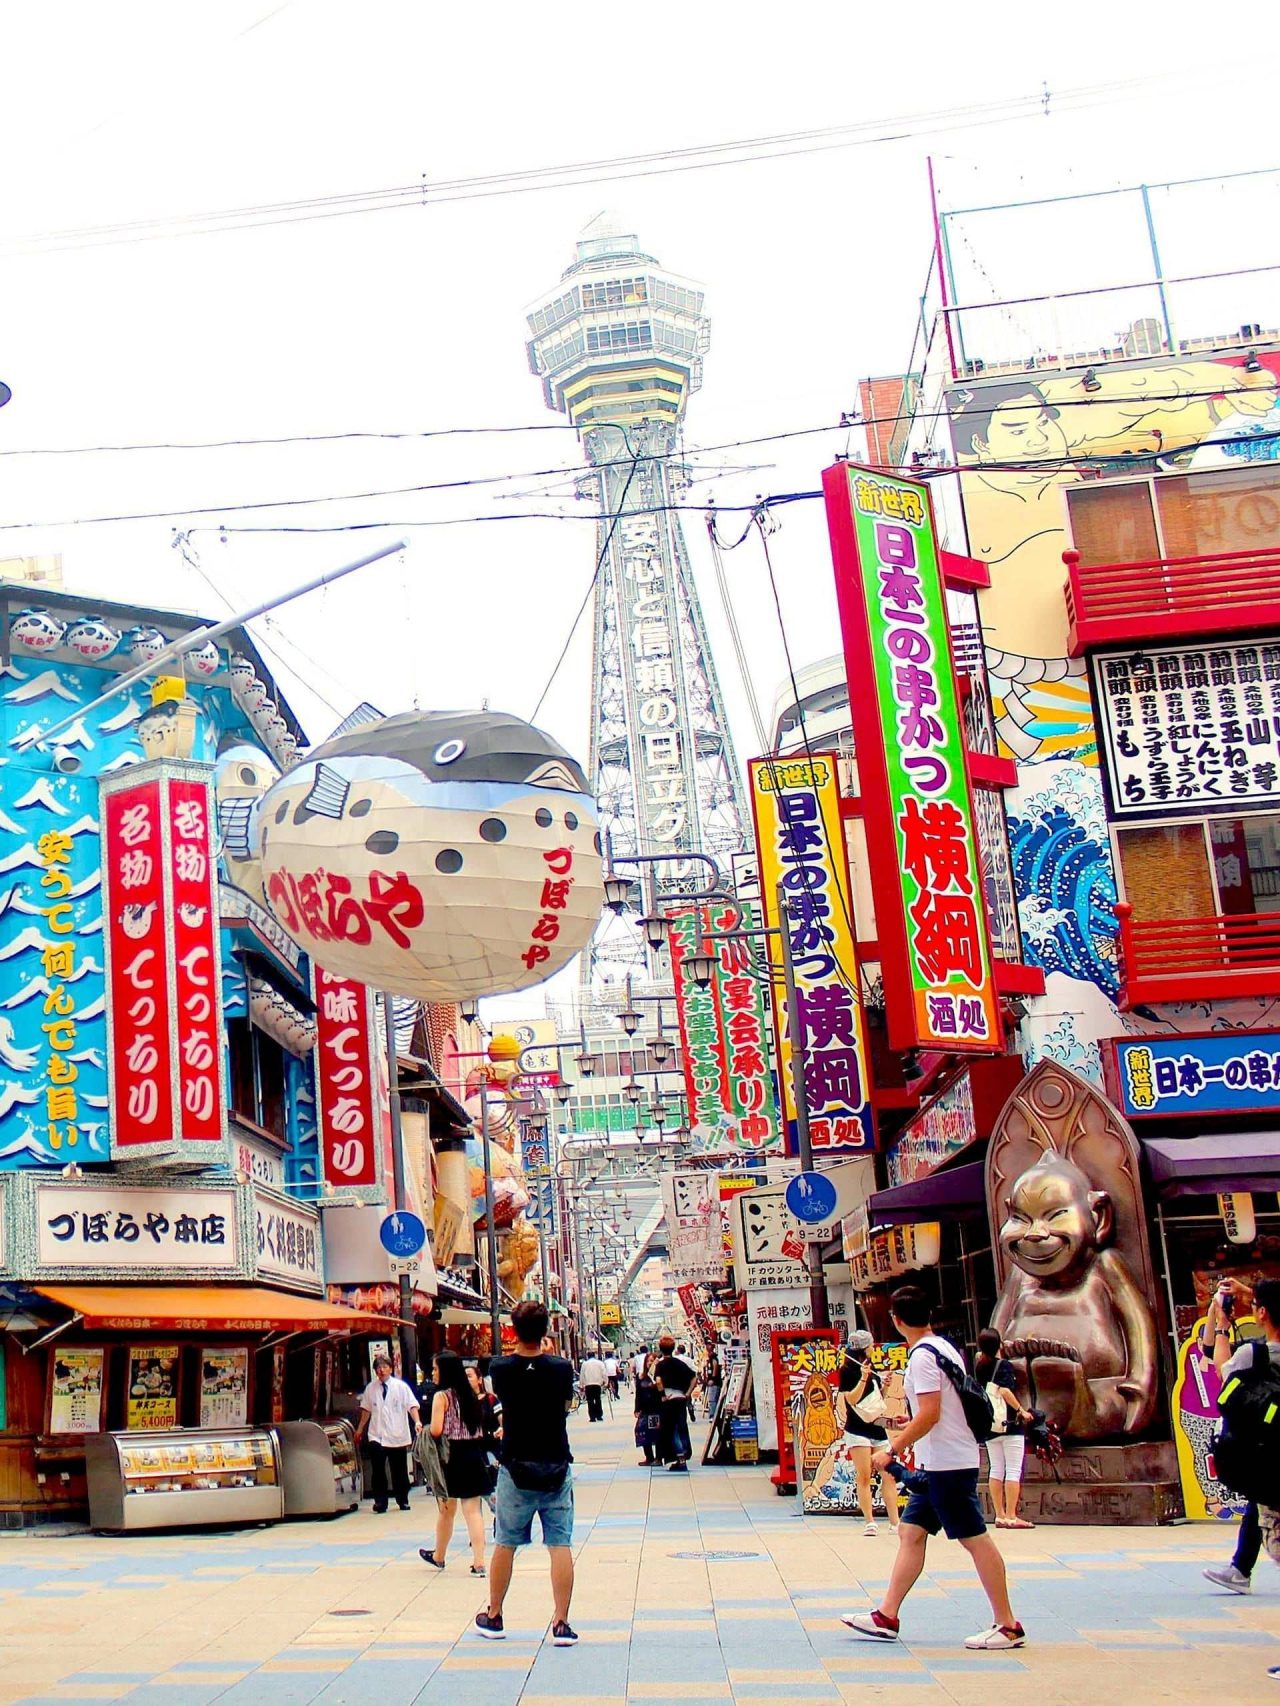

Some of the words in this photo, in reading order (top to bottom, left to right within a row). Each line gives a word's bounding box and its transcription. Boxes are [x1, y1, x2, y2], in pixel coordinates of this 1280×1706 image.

[854, 478, 925, 525] 新世界
[873, 524, 949, 794] 日本一の串かつ
[620, 514, 692, 880] 安心と信頼の日立グル
[758, 762, 829, 791] 新世界
[1116, 730, 1146, 803] もち
[1167, 725, 1201, 798] 紅しょうが
[1192, 723, 1222, 796] にんにく
[1220, 720, 1251, 794] 玉ねぎ
[1245, 717, 1278, 791] 山芋
[268, 866, 425, 949] づぼらや
[521, 845, 574, 970] づぼらや
[776, 791, 836, 980] 日本一の串かつ
[899, 797, 987, 988] 横綱
[37, 830, 79, 1150] 安うて何んでも旨い
[928, 993, 986, 1038] 酒処
[1127, 1048, 1156, 1107] 新世界
[48, 1211, 226, 1244] づぼらや本店
